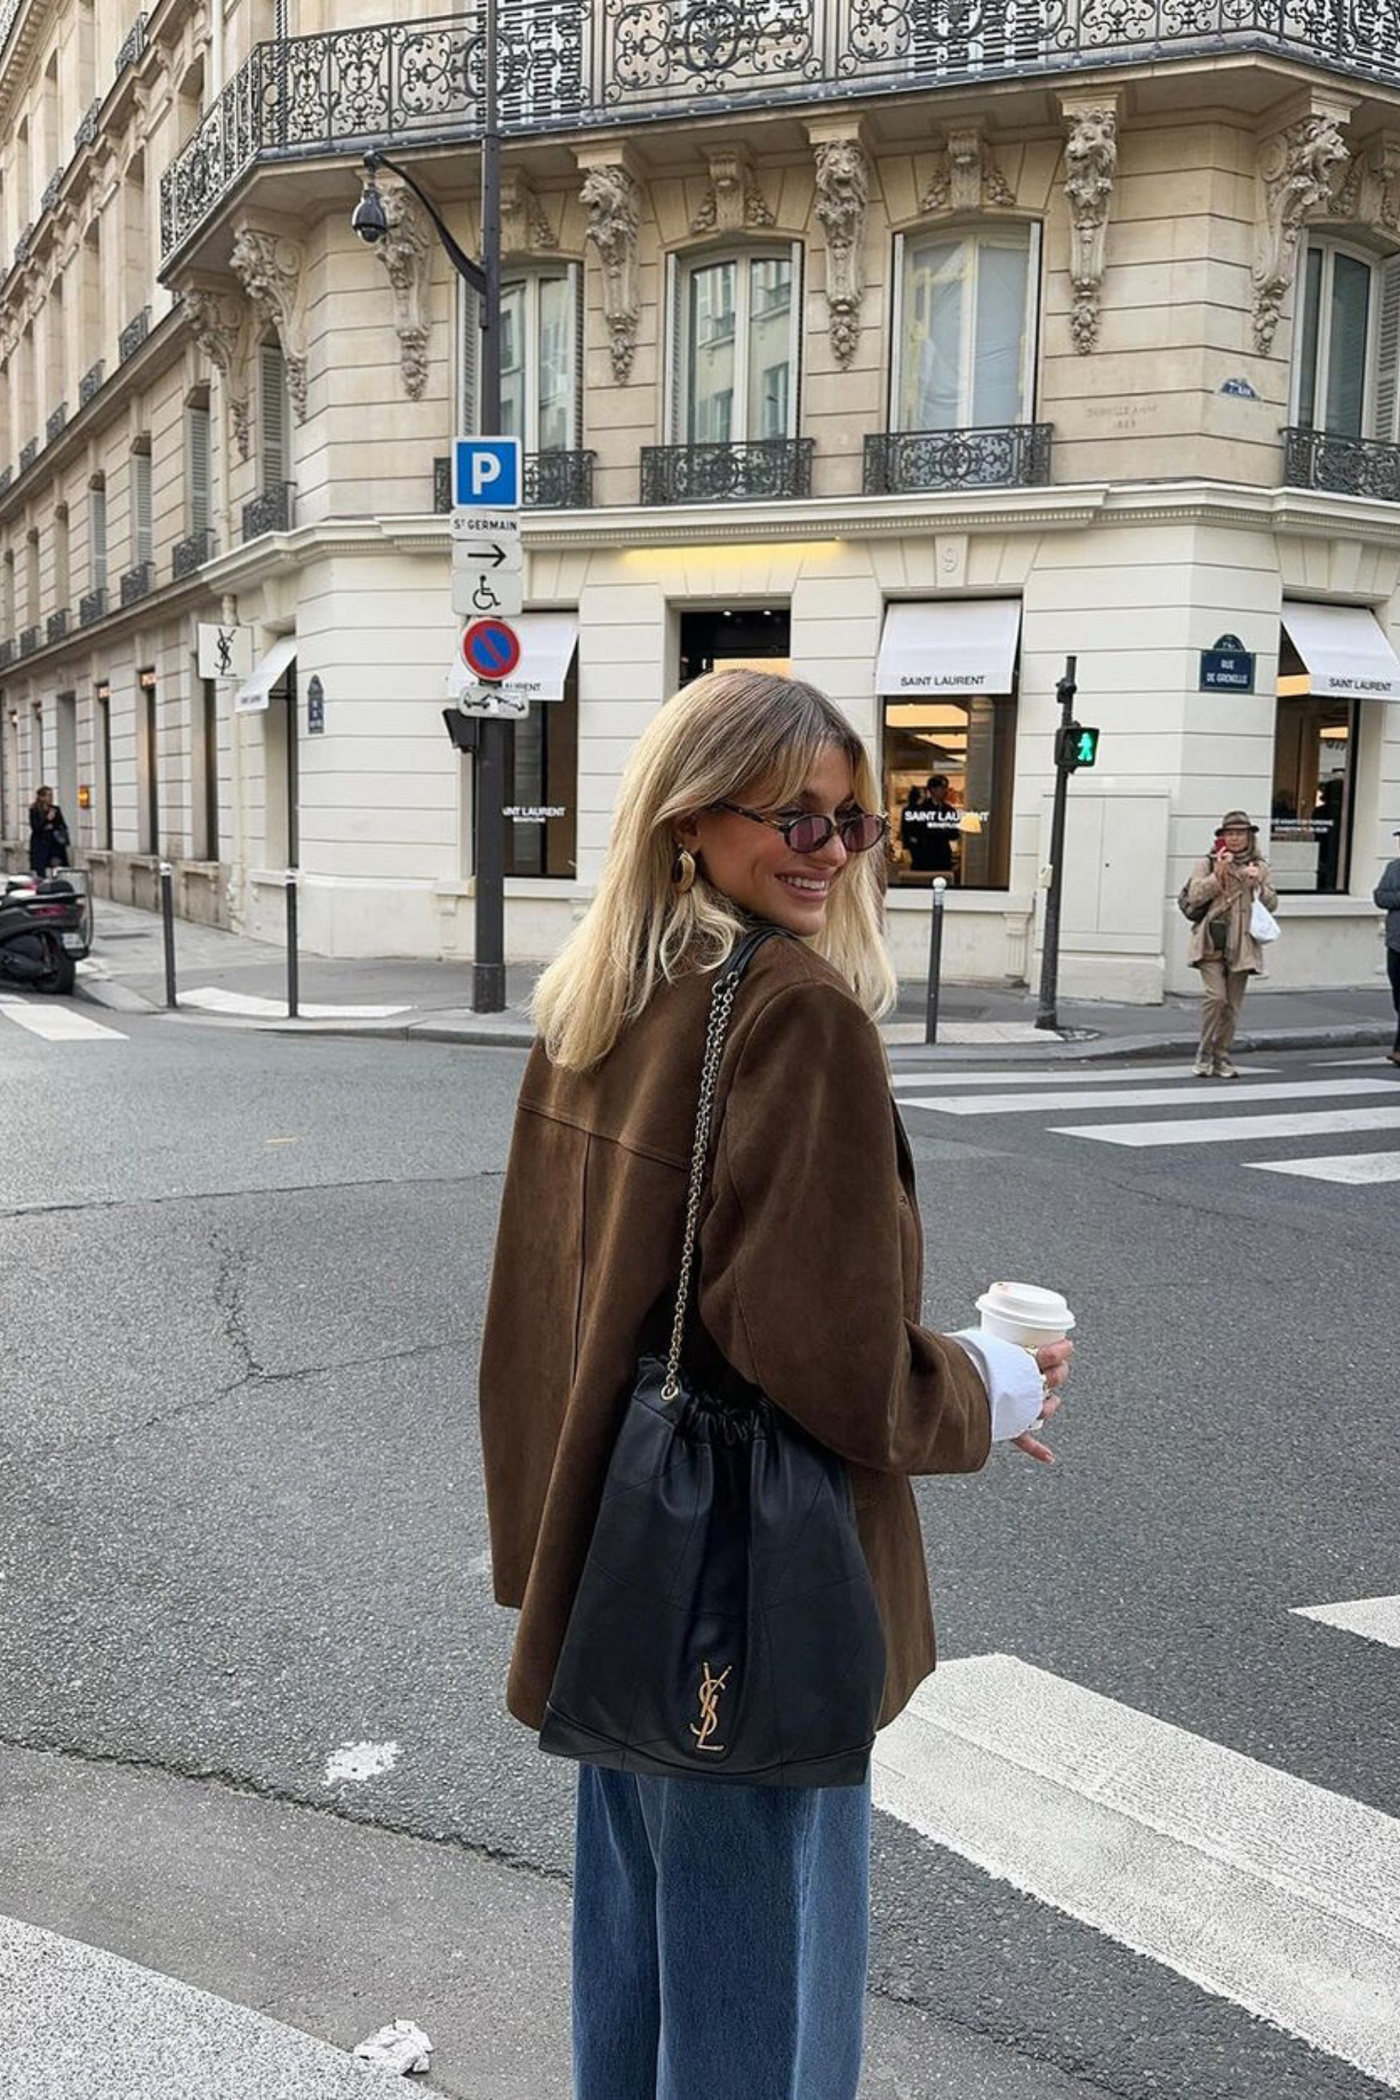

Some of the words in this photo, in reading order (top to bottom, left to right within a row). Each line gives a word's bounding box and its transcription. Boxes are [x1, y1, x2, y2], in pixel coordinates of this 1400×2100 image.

[471, 451, 501, 495] P
[467, 519, 517, 531] GERMAIN
[1221, 659, 1234, 670] RUE
[901, 676, 931, 687] SAINT
[934, 675, 985, 686] LAURENT
[1329, 677, 1352, 688] SAINT
[1354, 679, 1391, 691] LAURENT
[521, 806, 566, 817] LAURENT
[904, 810, 935, 822] SAINT
[938, 810, 989, 822] LAUNT
[689, 1661, 733, 1751] YSL
